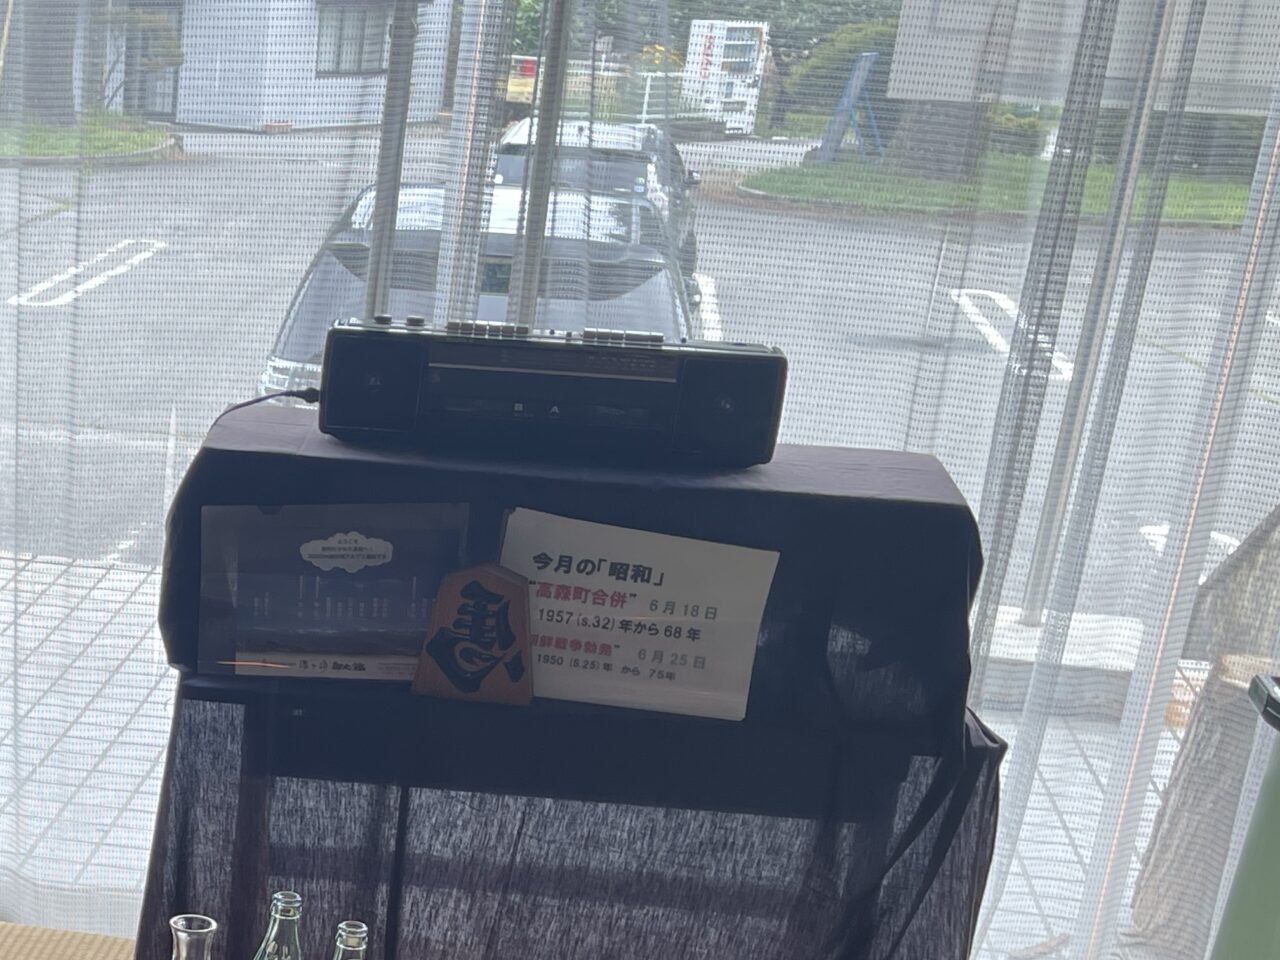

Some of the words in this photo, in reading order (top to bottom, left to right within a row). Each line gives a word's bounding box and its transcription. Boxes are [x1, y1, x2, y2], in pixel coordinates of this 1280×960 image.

[532, 552, 665, 587] 今月の「昭和」
